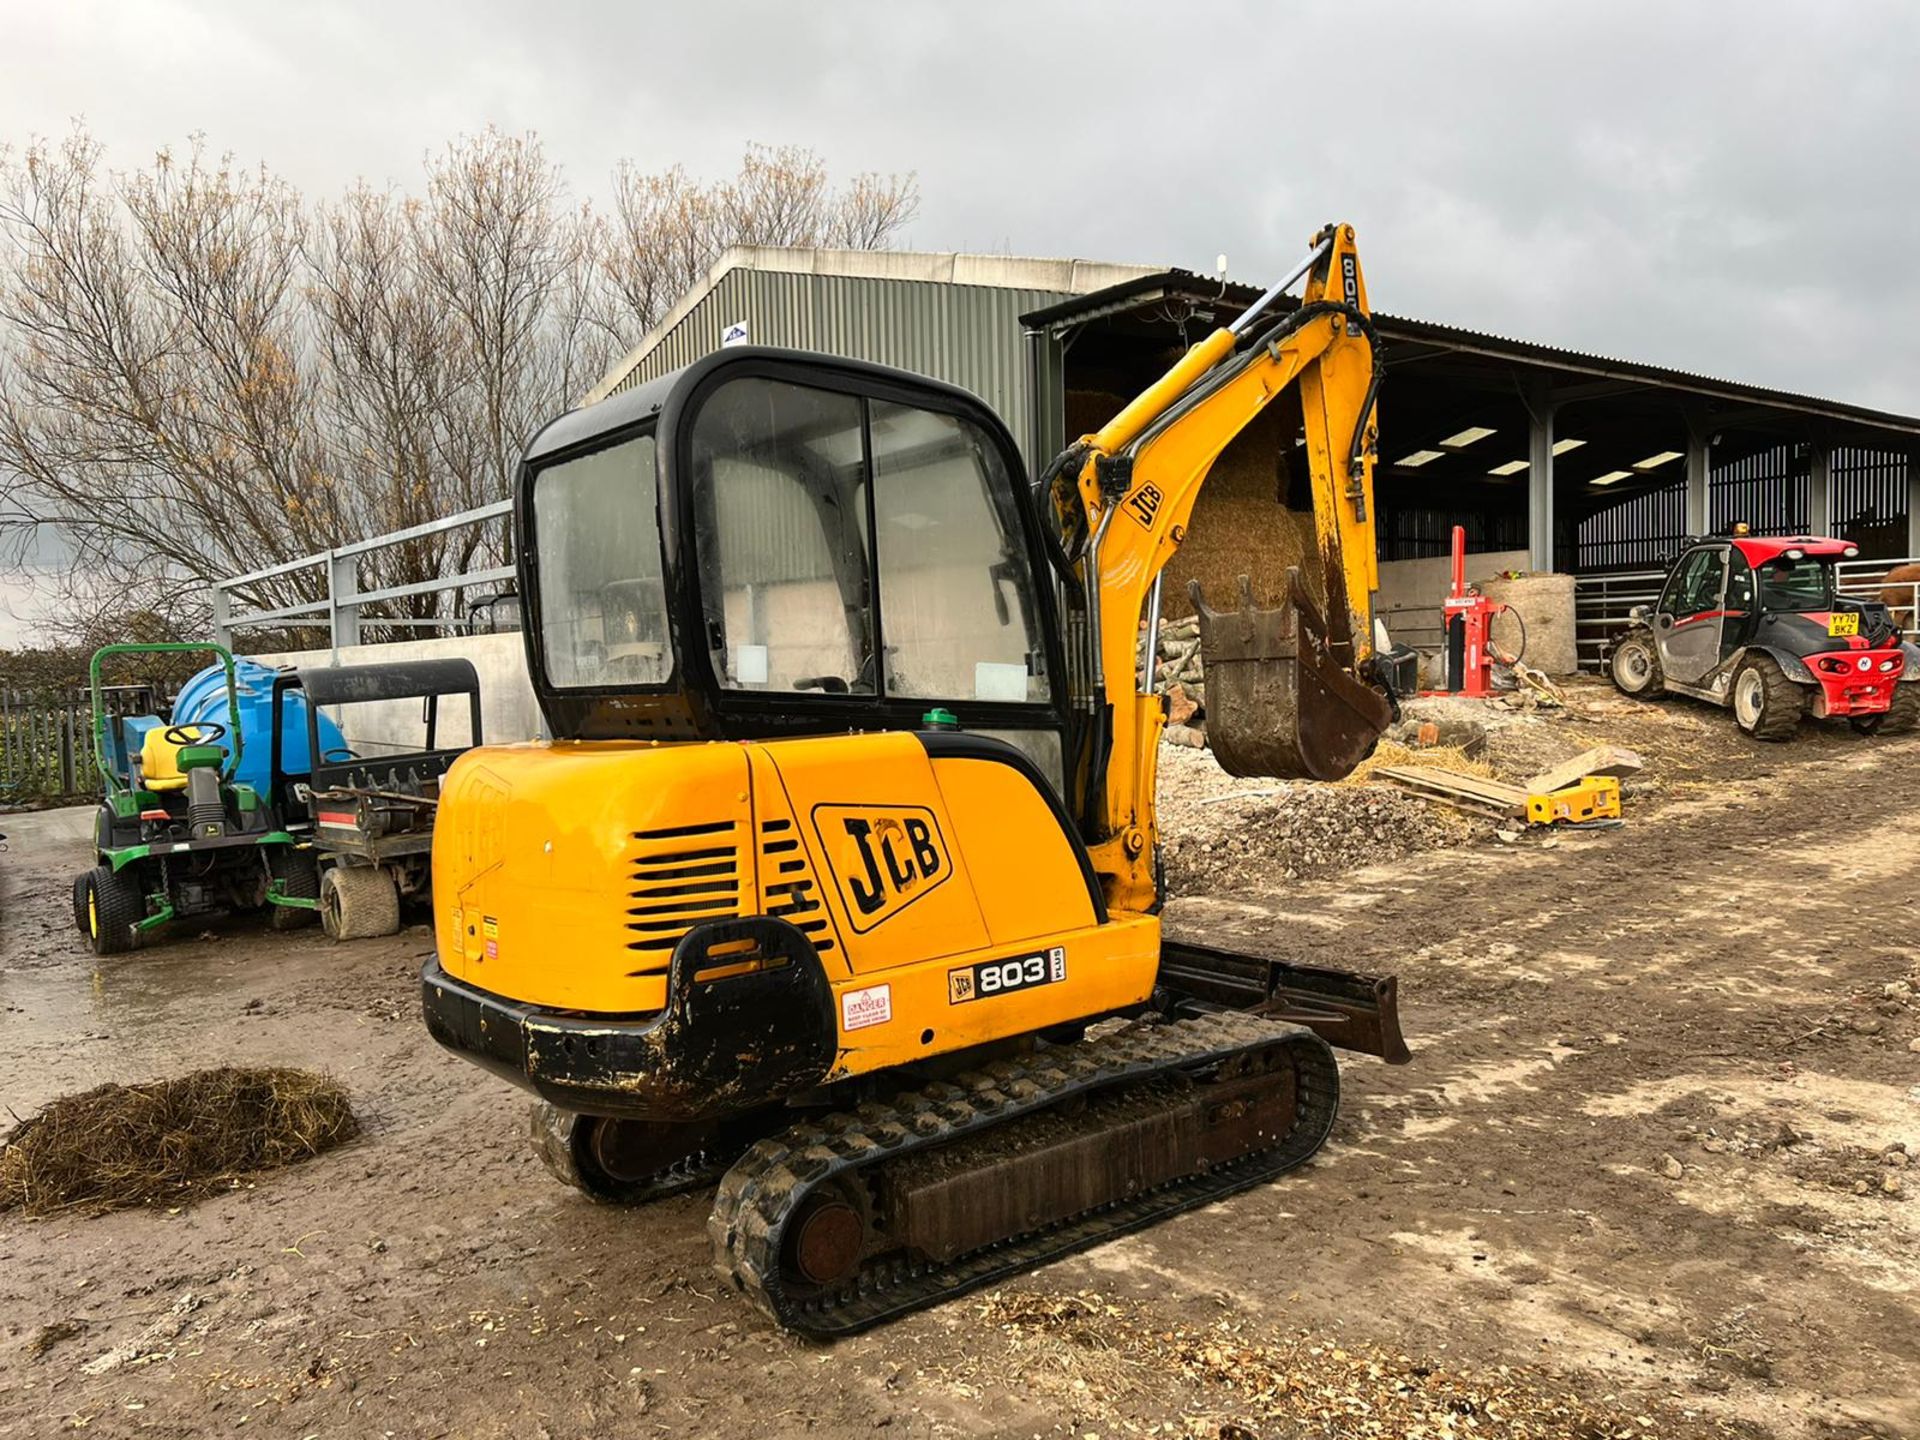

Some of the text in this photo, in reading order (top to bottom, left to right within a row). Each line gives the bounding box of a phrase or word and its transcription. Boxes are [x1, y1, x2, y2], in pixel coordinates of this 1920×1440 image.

[1130, 485, 1161, 526] JCB
[1832, 614, 1857, 624] YY70
[1834, 624, 1853, 634] BKZ
[843, 818, 940, 915] JCB
[955, 950, 1062, 996] JCB 803 PLUS
[848, 997, 886, 1015] DANGER
